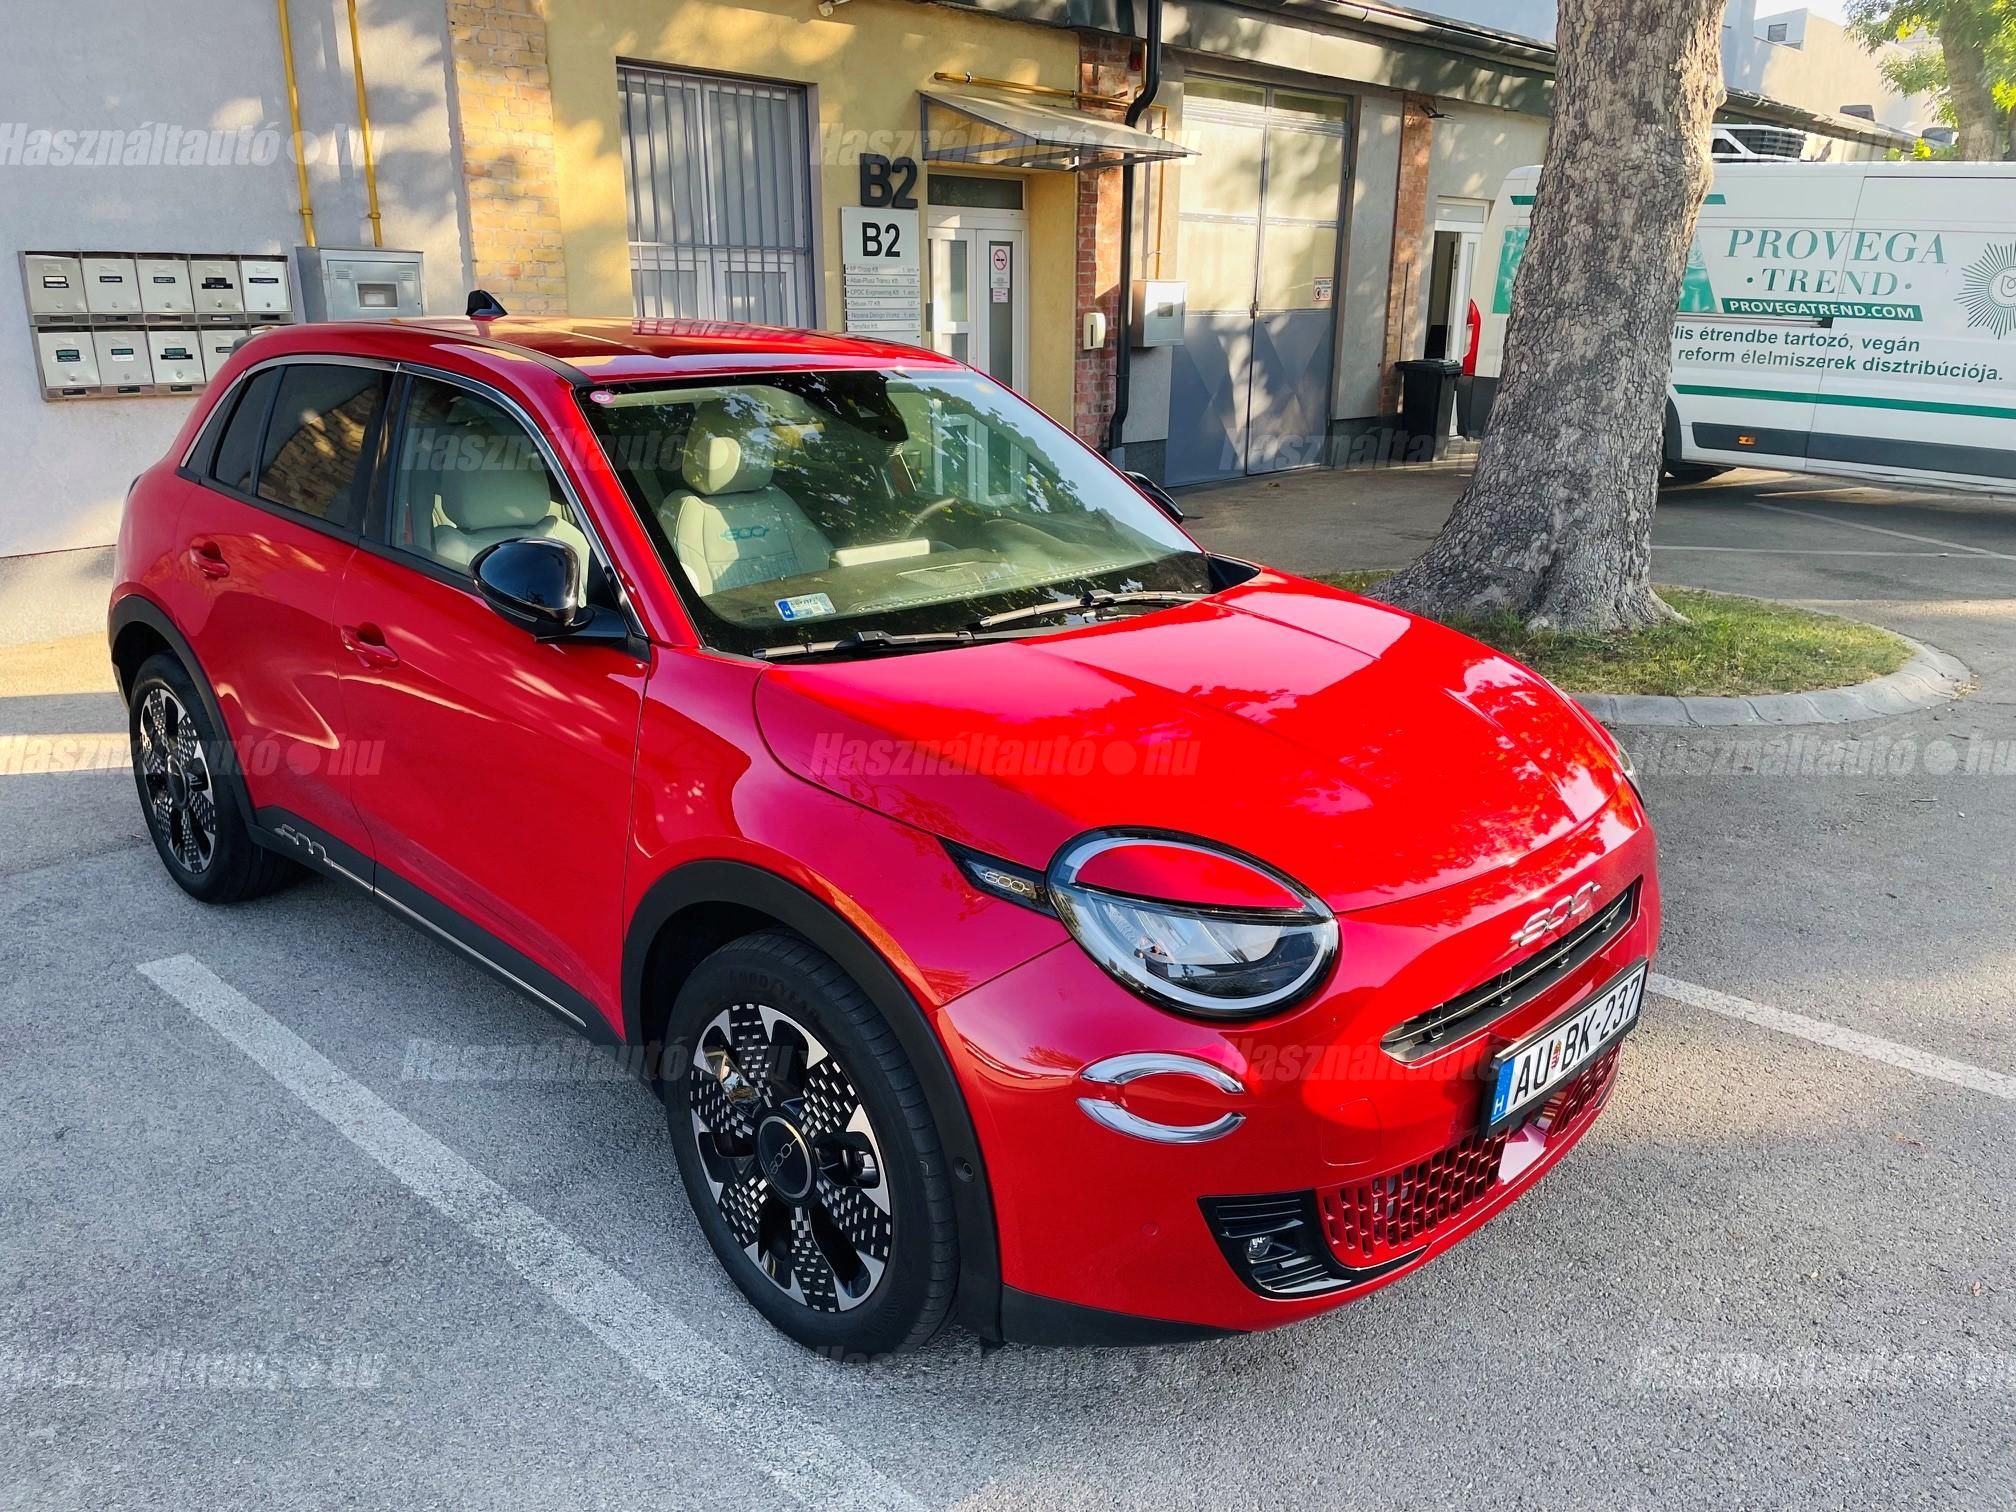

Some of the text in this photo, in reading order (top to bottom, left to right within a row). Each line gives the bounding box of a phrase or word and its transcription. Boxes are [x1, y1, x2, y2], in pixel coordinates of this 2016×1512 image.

[860, 153, 918, 209] B2
[862, 222, 900, 257] B2
[1724, 229, 1947, 264] PROVEGA
[1762, 268, 1898, 297] TREND
[1729, 301, 1915, 319] PROVEGATREND.COM
[1700, 327, 1778, 344] étrendbe
[1784, 331, 1854, 350] tartozó,
[1862, 336, 1920, 354] vegán
[1678, 347, 2003, 382] reform élelmiszerek disztribúciója.
[1493, 1100, 1505, 1116] H
